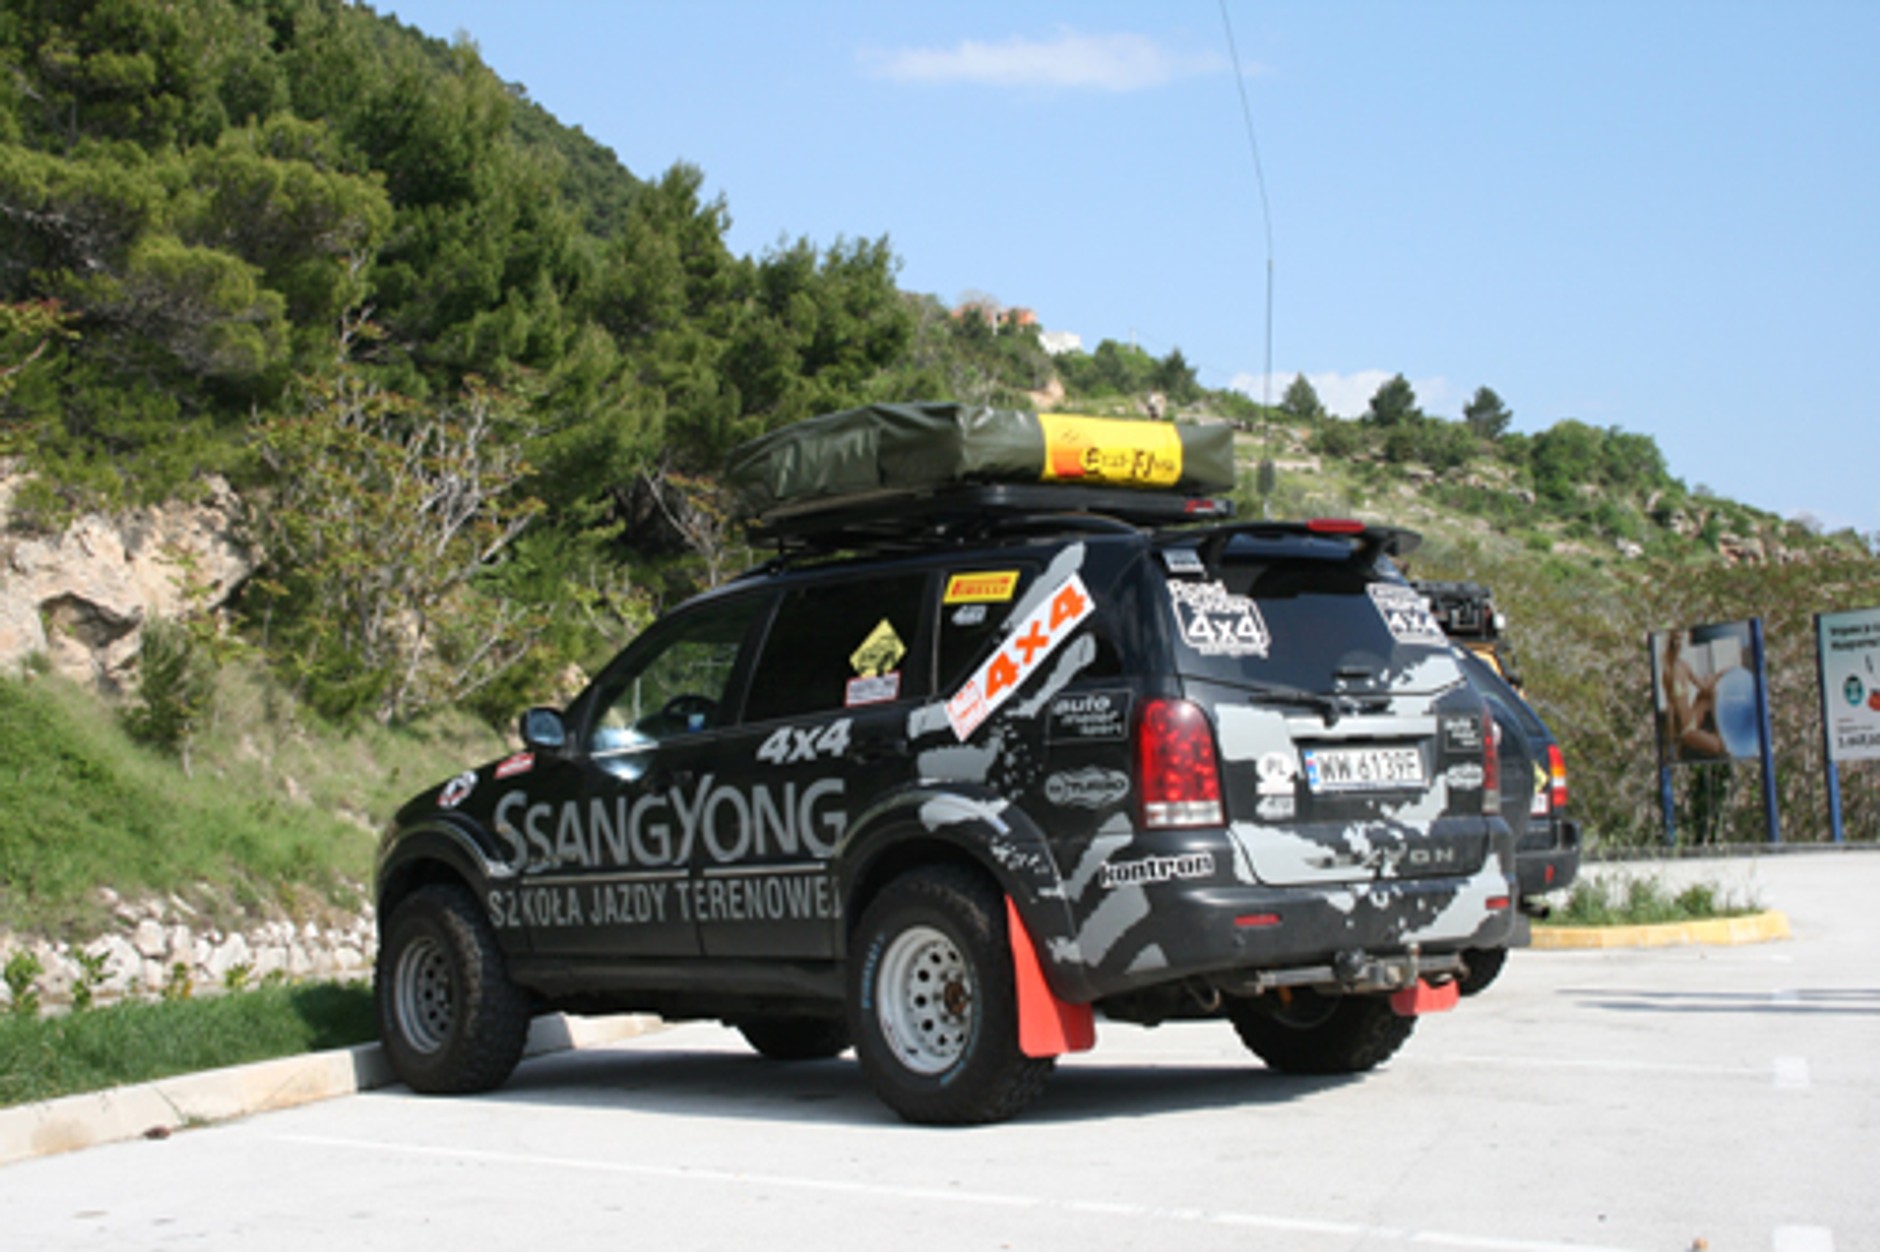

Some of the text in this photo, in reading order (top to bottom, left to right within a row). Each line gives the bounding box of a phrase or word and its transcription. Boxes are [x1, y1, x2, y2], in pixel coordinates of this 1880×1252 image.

[1187, 615, 1264, 645] 4x4
[756, 718, 853, 764] 4x4
[1317, 755, 1352, 780] WW
[493, 774, 848, 875] SSANGYONG
[1101, 852, 1215, 888] kontron
[488, 886, 584, 928] SZKOŁA
[590, 882, 668, 925] JAZDY
